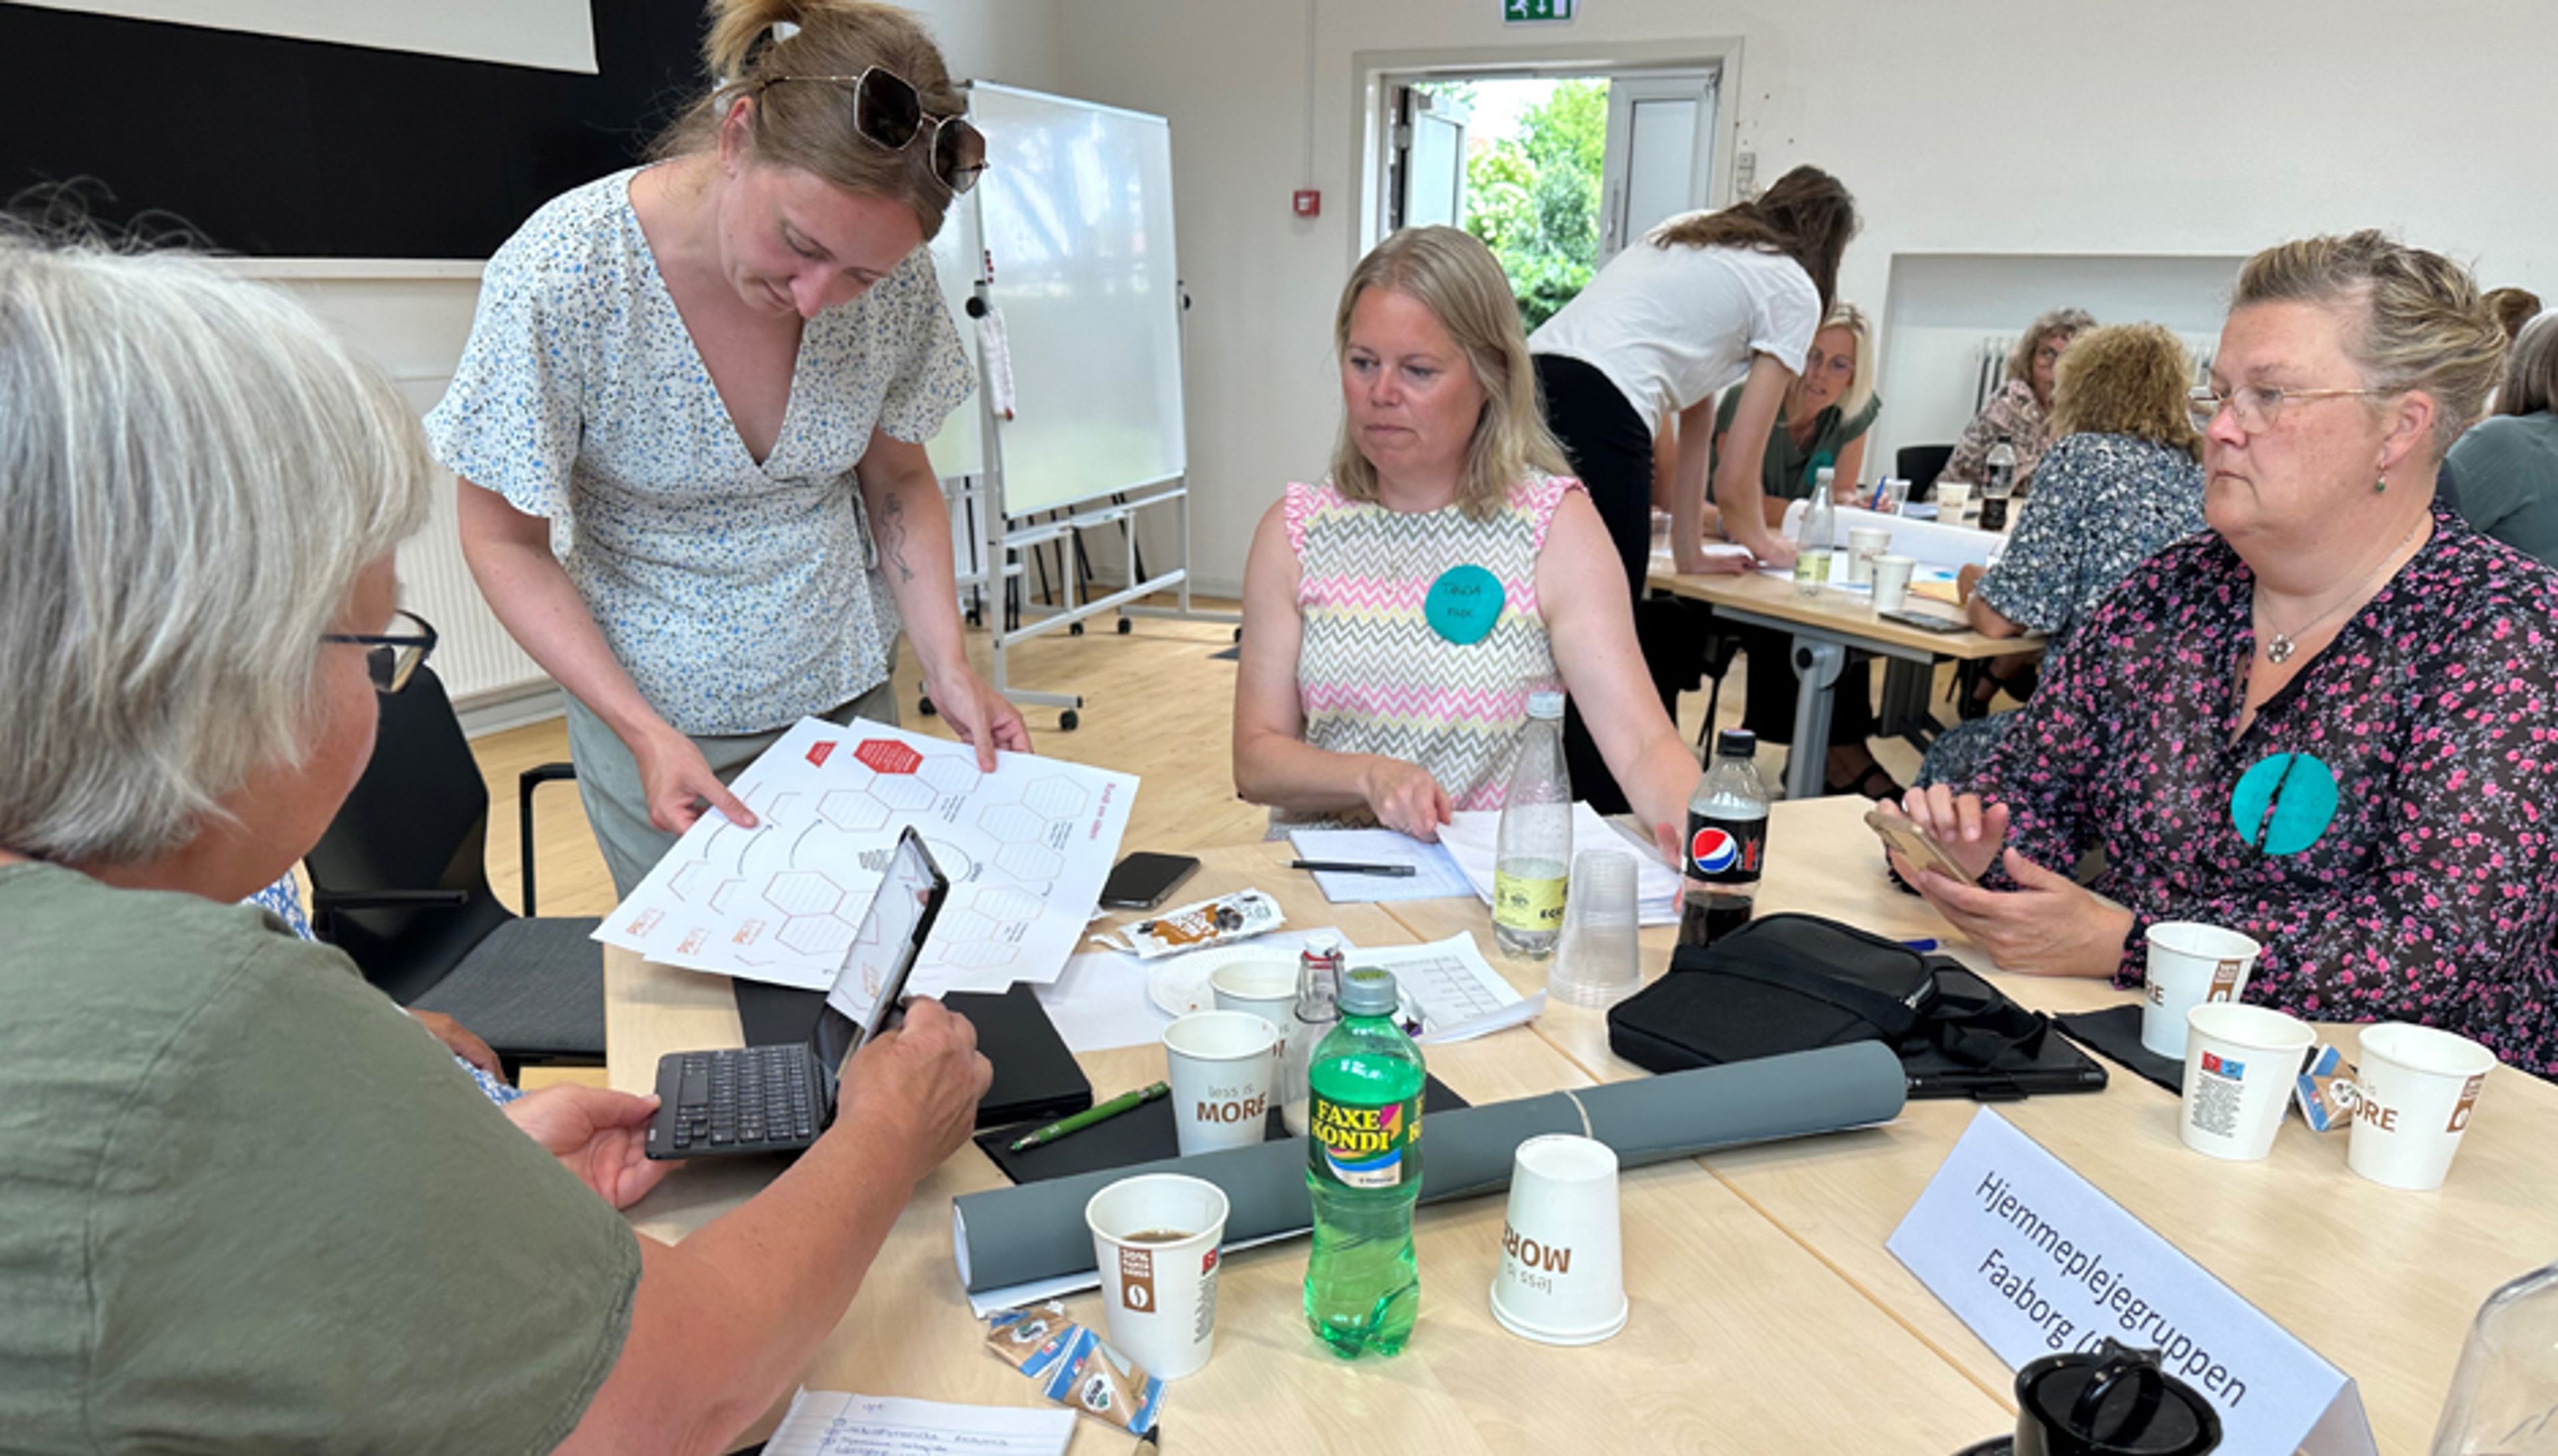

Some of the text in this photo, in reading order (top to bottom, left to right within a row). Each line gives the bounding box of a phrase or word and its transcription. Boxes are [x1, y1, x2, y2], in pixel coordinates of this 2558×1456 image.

[1208, 1082, 1253, 1098] less is
[1197, 1091, 1266, 1124] MORE
[1318, 1099, 1381, 1130] FAXE
[1311, 1116, 1390, 1151] KONDI
[1975, 1171, 2247, 1407] Hjemmeplejegruppen
[1978, 1248, 2076, 1350] Faaborg
